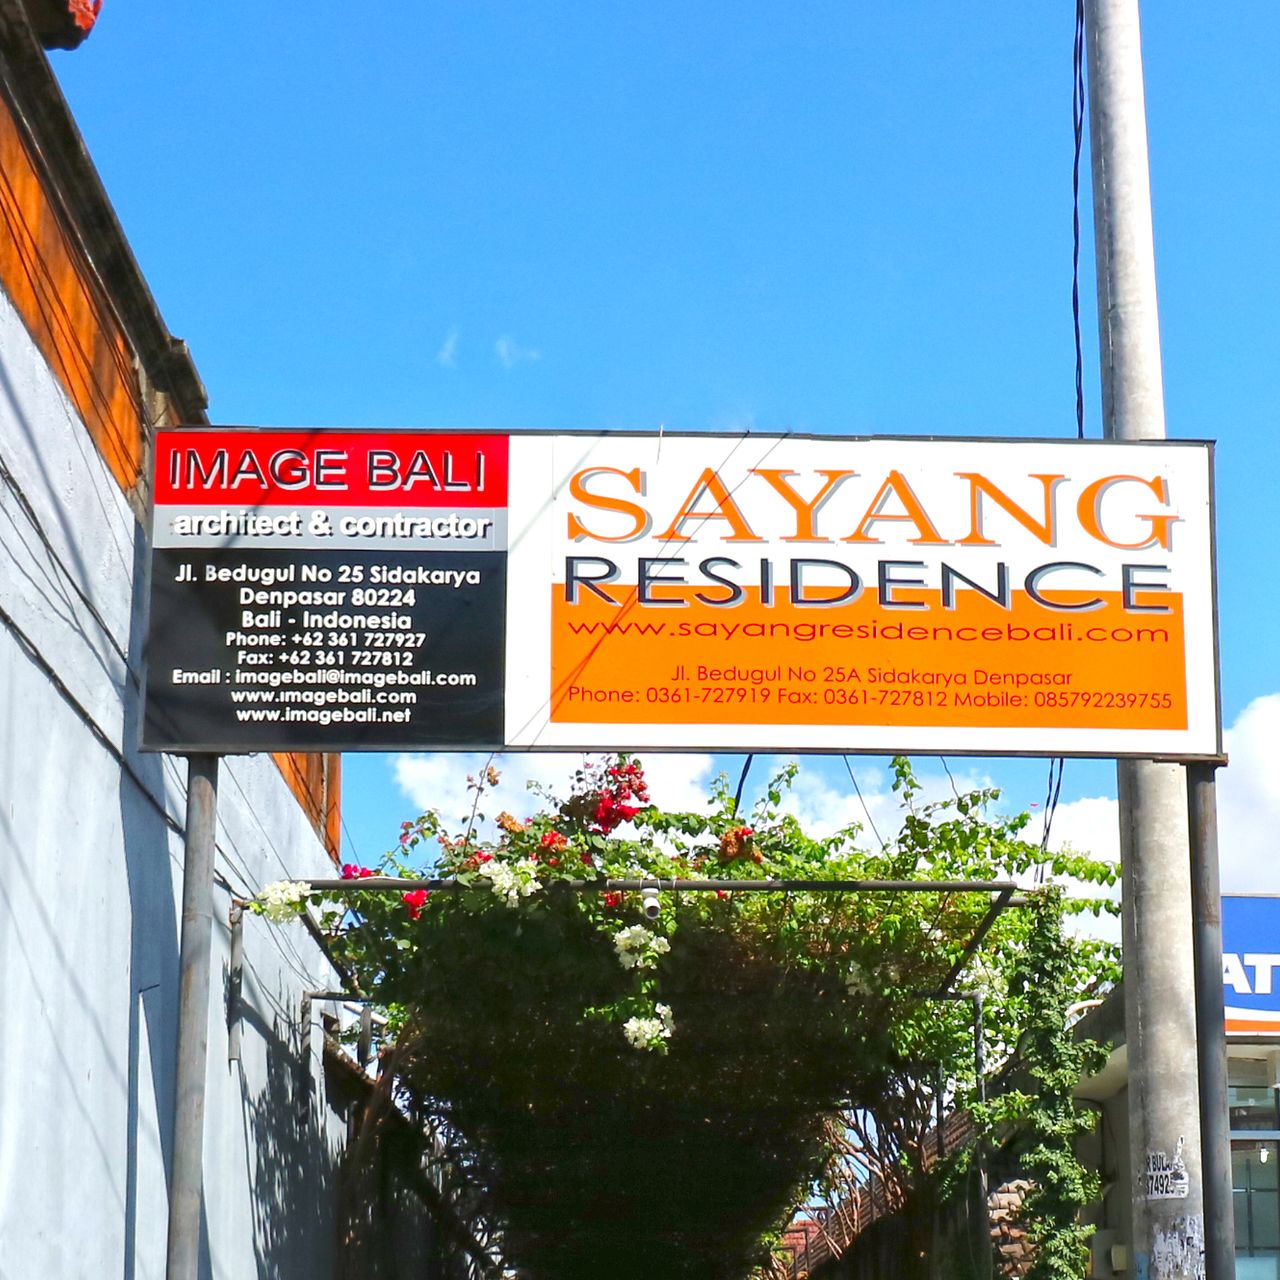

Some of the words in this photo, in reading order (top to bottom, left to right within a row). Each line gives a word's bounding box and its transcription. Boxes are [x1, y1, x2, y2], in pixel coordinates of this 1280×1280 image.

[170, 449, 349, 491] IMAGE
[368, 450, 486, 491] BALI
[566, 466, 1186, 550] SAYANG
[172, 509, 301, 538] architect
[308, 510, 333, 536] &
[339, 513, 493, 539] contractor
[175, 563, 198, 582] Jl.
[205, 564, 295, 586] Bedugul
[301, 564, 333, 583] No
[337, 564, 364, 583] 25
[370, 565, 481, 588] Sidakarya
[563, 555, 1175, 614] RESIDENCE
[239, 587, 347, 609] Denpasar
[351, 588, 416, 607] 80224
[241, 610, 282, 628] Bali
[303, 611, 412, 629] Indonesia
[567, 619, 1170, 642] www.sayangresidencebali.com
[225, 631, 287, 646] Phone:
[291, 632, 324, 646] +62
[328, 632, 357, 647] 361
[364, 632, 426, 648] 727927
[237, 650, 274, 665] Fax:
[279, 650, 311, 665] +62
[314, 650, 345, 665] 361
[351, 651, 414, 666] 727812
[172, 669, 221, 684] Email
[235, 668, 477, 687] imagebali@imagebali.com
[671, 665, 690, 681] Jl.
[697, 665, 782, 685] Bedugul
[787, 666, 816, 682] No
[822, 667, 862, 683] 25A
[867, 667, 967, 689] Sidakarya
[974, 669, 1073, 689] Denpasar
[230, 688, 417, 706] www.imagebali.com
[568, 686, 640, 703] Phone:
[645, 686, 771, 704] 0361-727919
[777, 687, 818, 704] Fax:
[823, 688, 947, 706] 0361-727812
[954, 691, 1028, 707] Mobile:
[1034, 692, 1172, 709] 085792239755
[235, 706, 412, 725] www.imagebali.net
